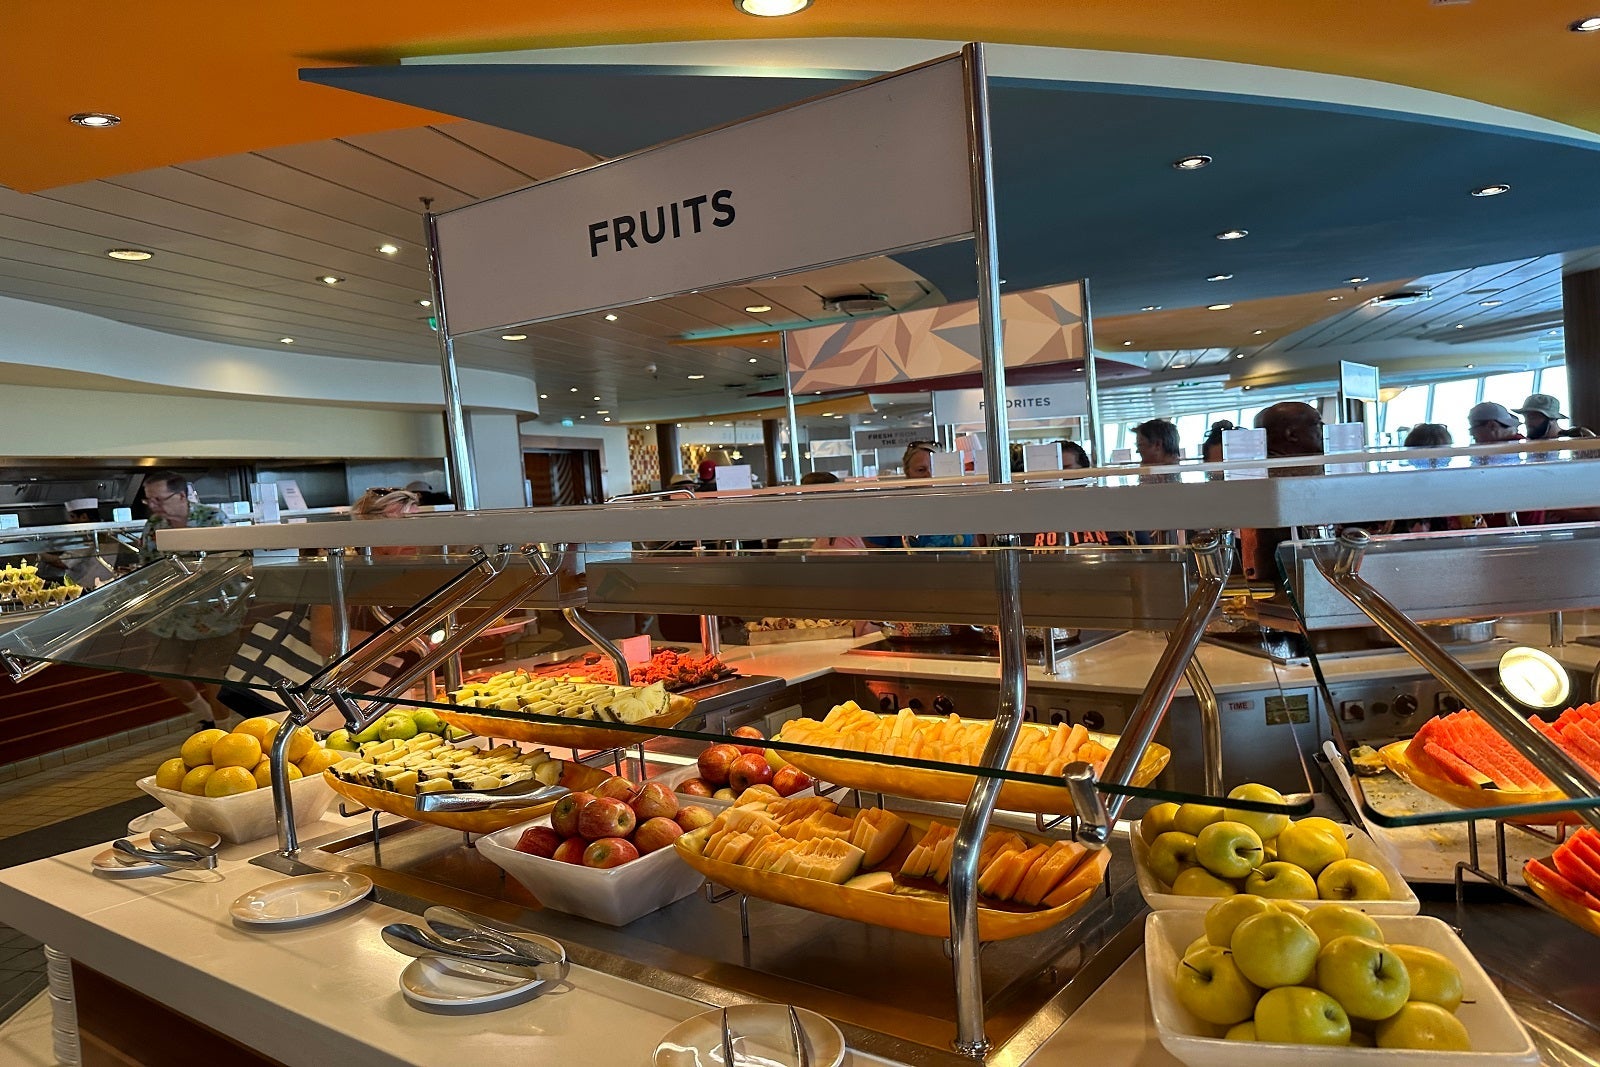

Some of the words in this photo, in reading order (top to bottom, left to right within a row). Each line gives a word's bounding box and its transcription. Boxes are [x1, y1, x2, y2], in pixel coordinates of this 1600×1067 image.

[588, 189, 736, 258] FRUITS
[979, 397, 1051, 410] FORITES
[868, 432, 893, 440] FRESH
[1228, 701, 1249, 711] TIME
